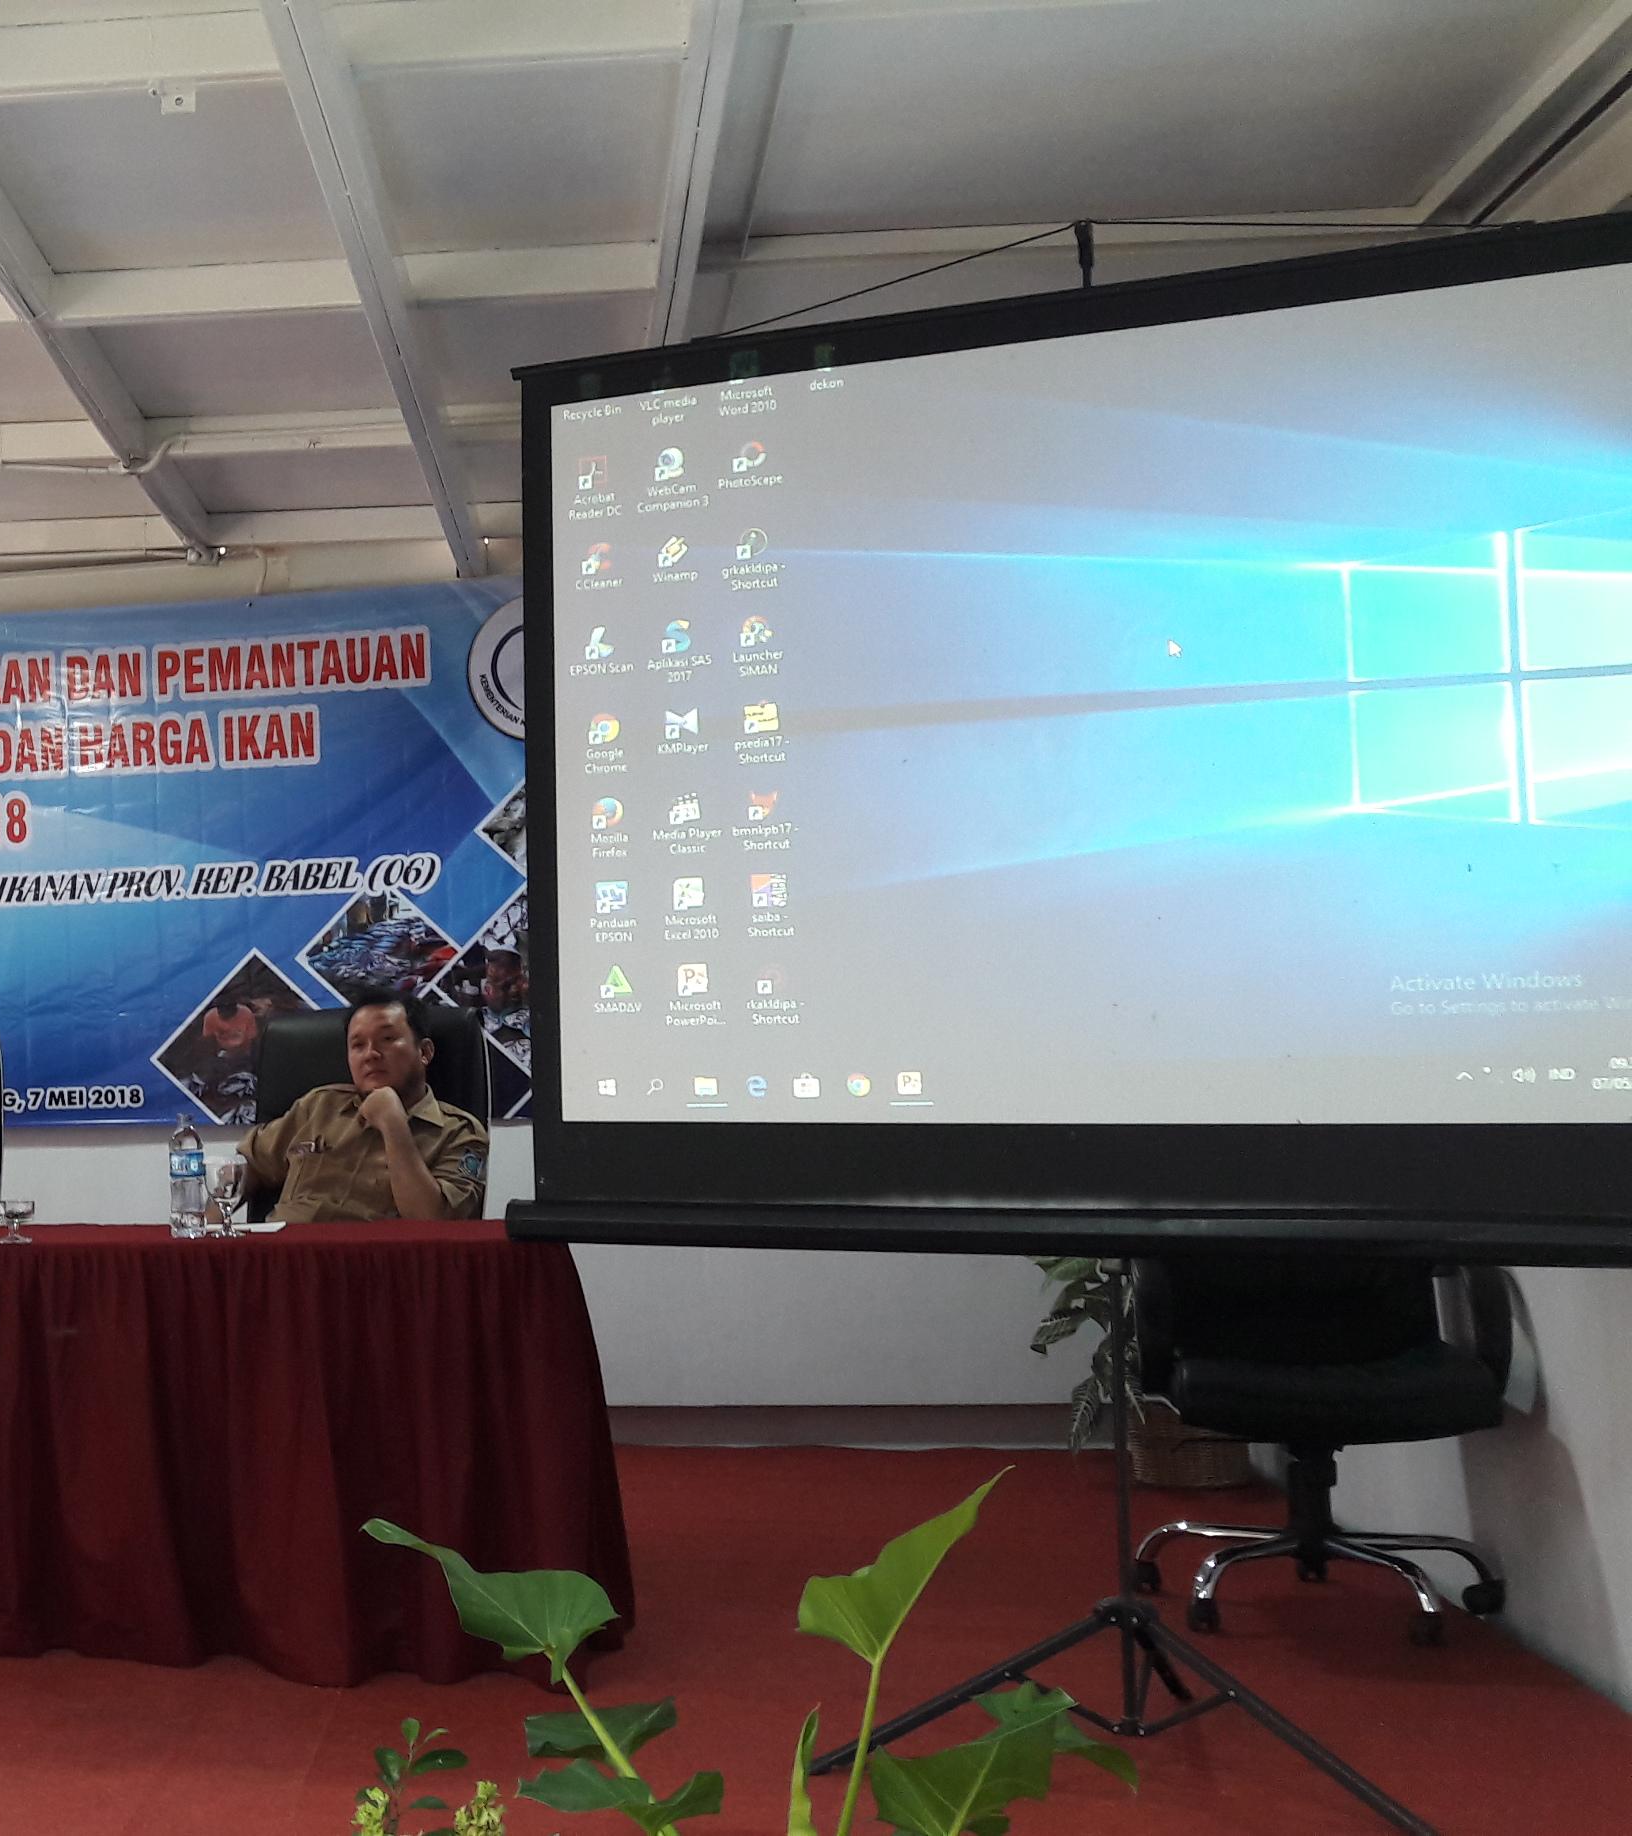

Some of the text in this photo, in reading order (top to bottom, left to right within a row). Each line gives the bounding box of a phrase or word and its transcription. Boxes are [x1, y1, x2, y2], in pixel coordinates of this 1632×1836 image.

[809, 377, 844, 391] dekon
[720, 386, 773, 401] Microsoft
[639, 396, 698, 411] VLC media
[719, 400, 778, 416] Word 2010
[563, 405, 622, 421] Recycle Bin
[651, 412, 685, 426] player
[718, 473, 783, 490] PhotoScape
[647, 482, 697, 498] WebCam
[574, 491, 615, 506] Acrobat
[637, 495, 709, 514] Companion 3
[569, 505, 623, 521] Reader DC
[652, 569, 699, 583] Winamp
[575, 576, 624, 591] CCleaner
[731, 577, 779, 591] Shortcut
[647, 654, 712, 672] Aplikasi SAS
[732, 649, 783, 664] Launcher
[68, 650, 143, 699] DAN
[157, 631, 428, 694] PEMANTAUAN
[570, 661, 635, 676] EPSON Scan
[739, 662, 778, 676] SIMAN
[667, 670, 692, 683] 2017
[479, 673, 521, 725] KEMENTERIAN
[76, 716, 210, 769] HARGA
[223, 710, 316, 761] IKAN
[586, 747, 624, 762] Google
[657, 742, 709, 755] KMPlayer
[739, 752, 786, 765] Shortcut
[584, 763, 627, 774] Chrome
[590, 832, 629, 844] Mozilla
[653, 828, 723, 841] Media Player
[669, 843, 706, 855] Classic
[743, 838, 791, 851] Shortcut
[592, 846, 628, 858] Firefox
[105, 868, 183, 901] PROV.
[190, 865, 257, 896] KEP.
[264, 860, 360, 892] BABEL
[366, 851, 441, 894] (06)
[590, 918, 637, 929] Panduan
[665, 914, 718, 926] Microsoft
[752, 912, 781, 923] saiba
[595, 931, 633, 943] EPSON
[664, 928, 720, 941] Excel 2010
[747, 926, 795, 937] Shortcut
[1390, 969, 1584, 993] Activate Windows
[594, 1001, 642, 1013] SMADAV
[669, 1000, 721, 1012] Microsoft
[752, 1013, 801, 1025] Shortcut
[27, 1091, 42, 1110] 7
[48, 1088, 87, 1109] MEI
[88, 1087, 145, 1108] 2018
